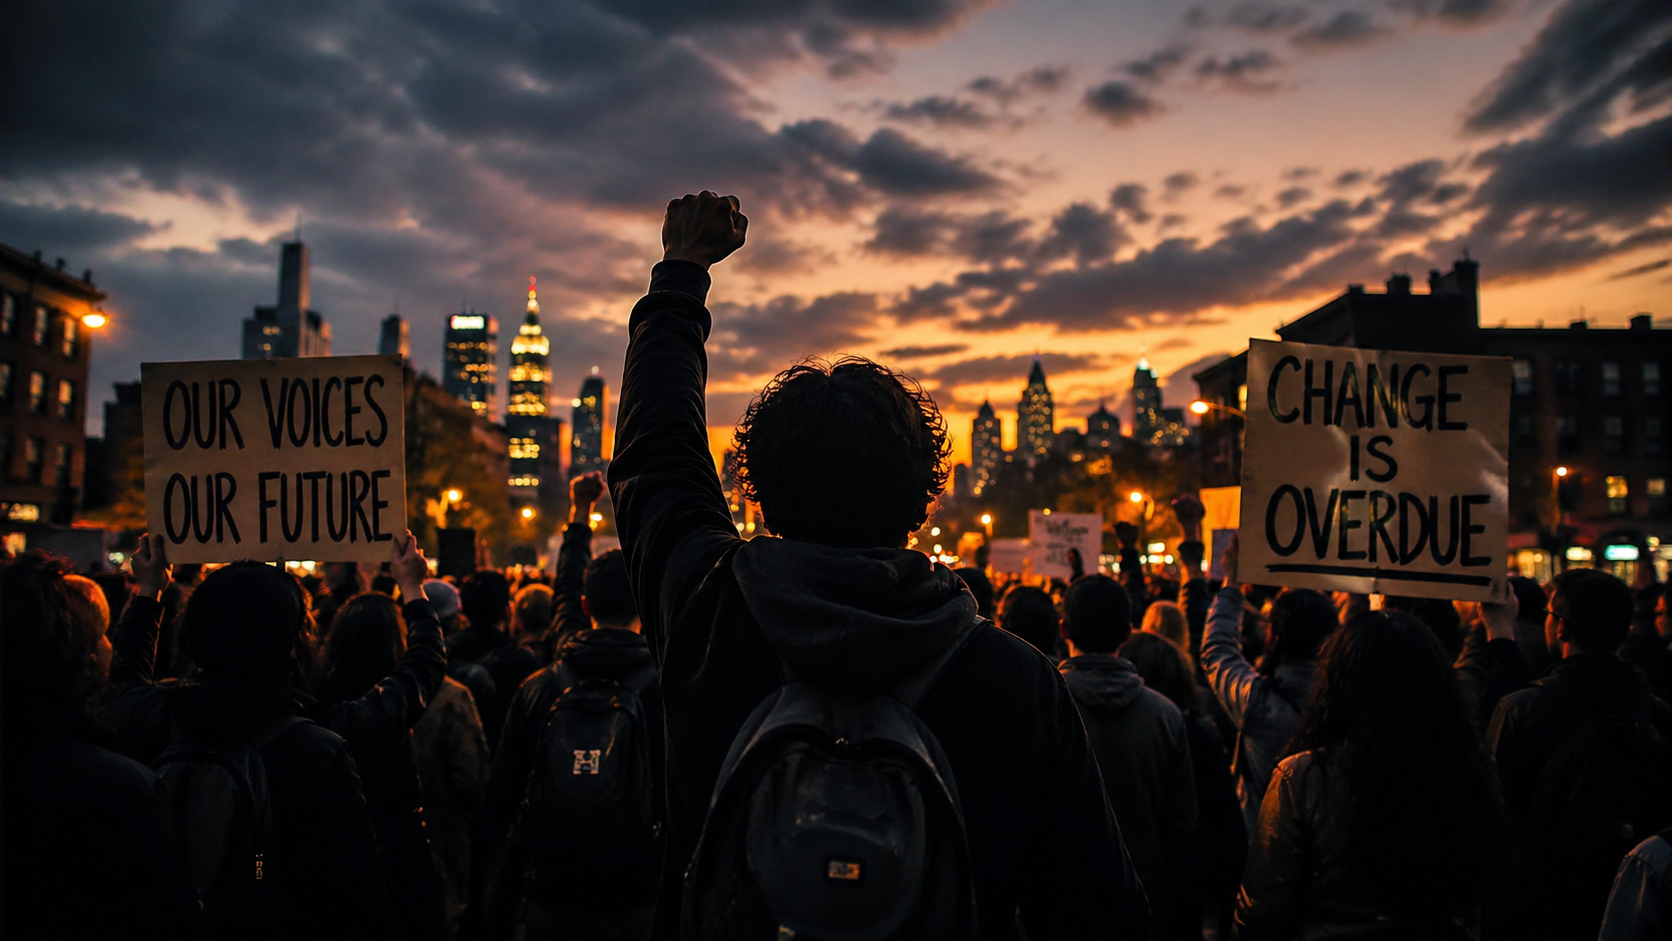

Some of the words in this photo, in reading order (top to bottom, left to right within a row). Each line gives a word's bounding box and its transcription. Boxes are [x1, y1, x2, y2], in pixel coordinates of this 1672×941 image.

[162, 378, 245, 451] OUR
[260, 374, 388, 450] VOICES
[1267, 355, 1469, 432] CHANGE
[1350, 435, 1399, 483] IS
[163, 472, 242, 545] OUR
[258, 469, 393, 543] FUTURE
[1265, 484, 1492, 567] OVERDUE
